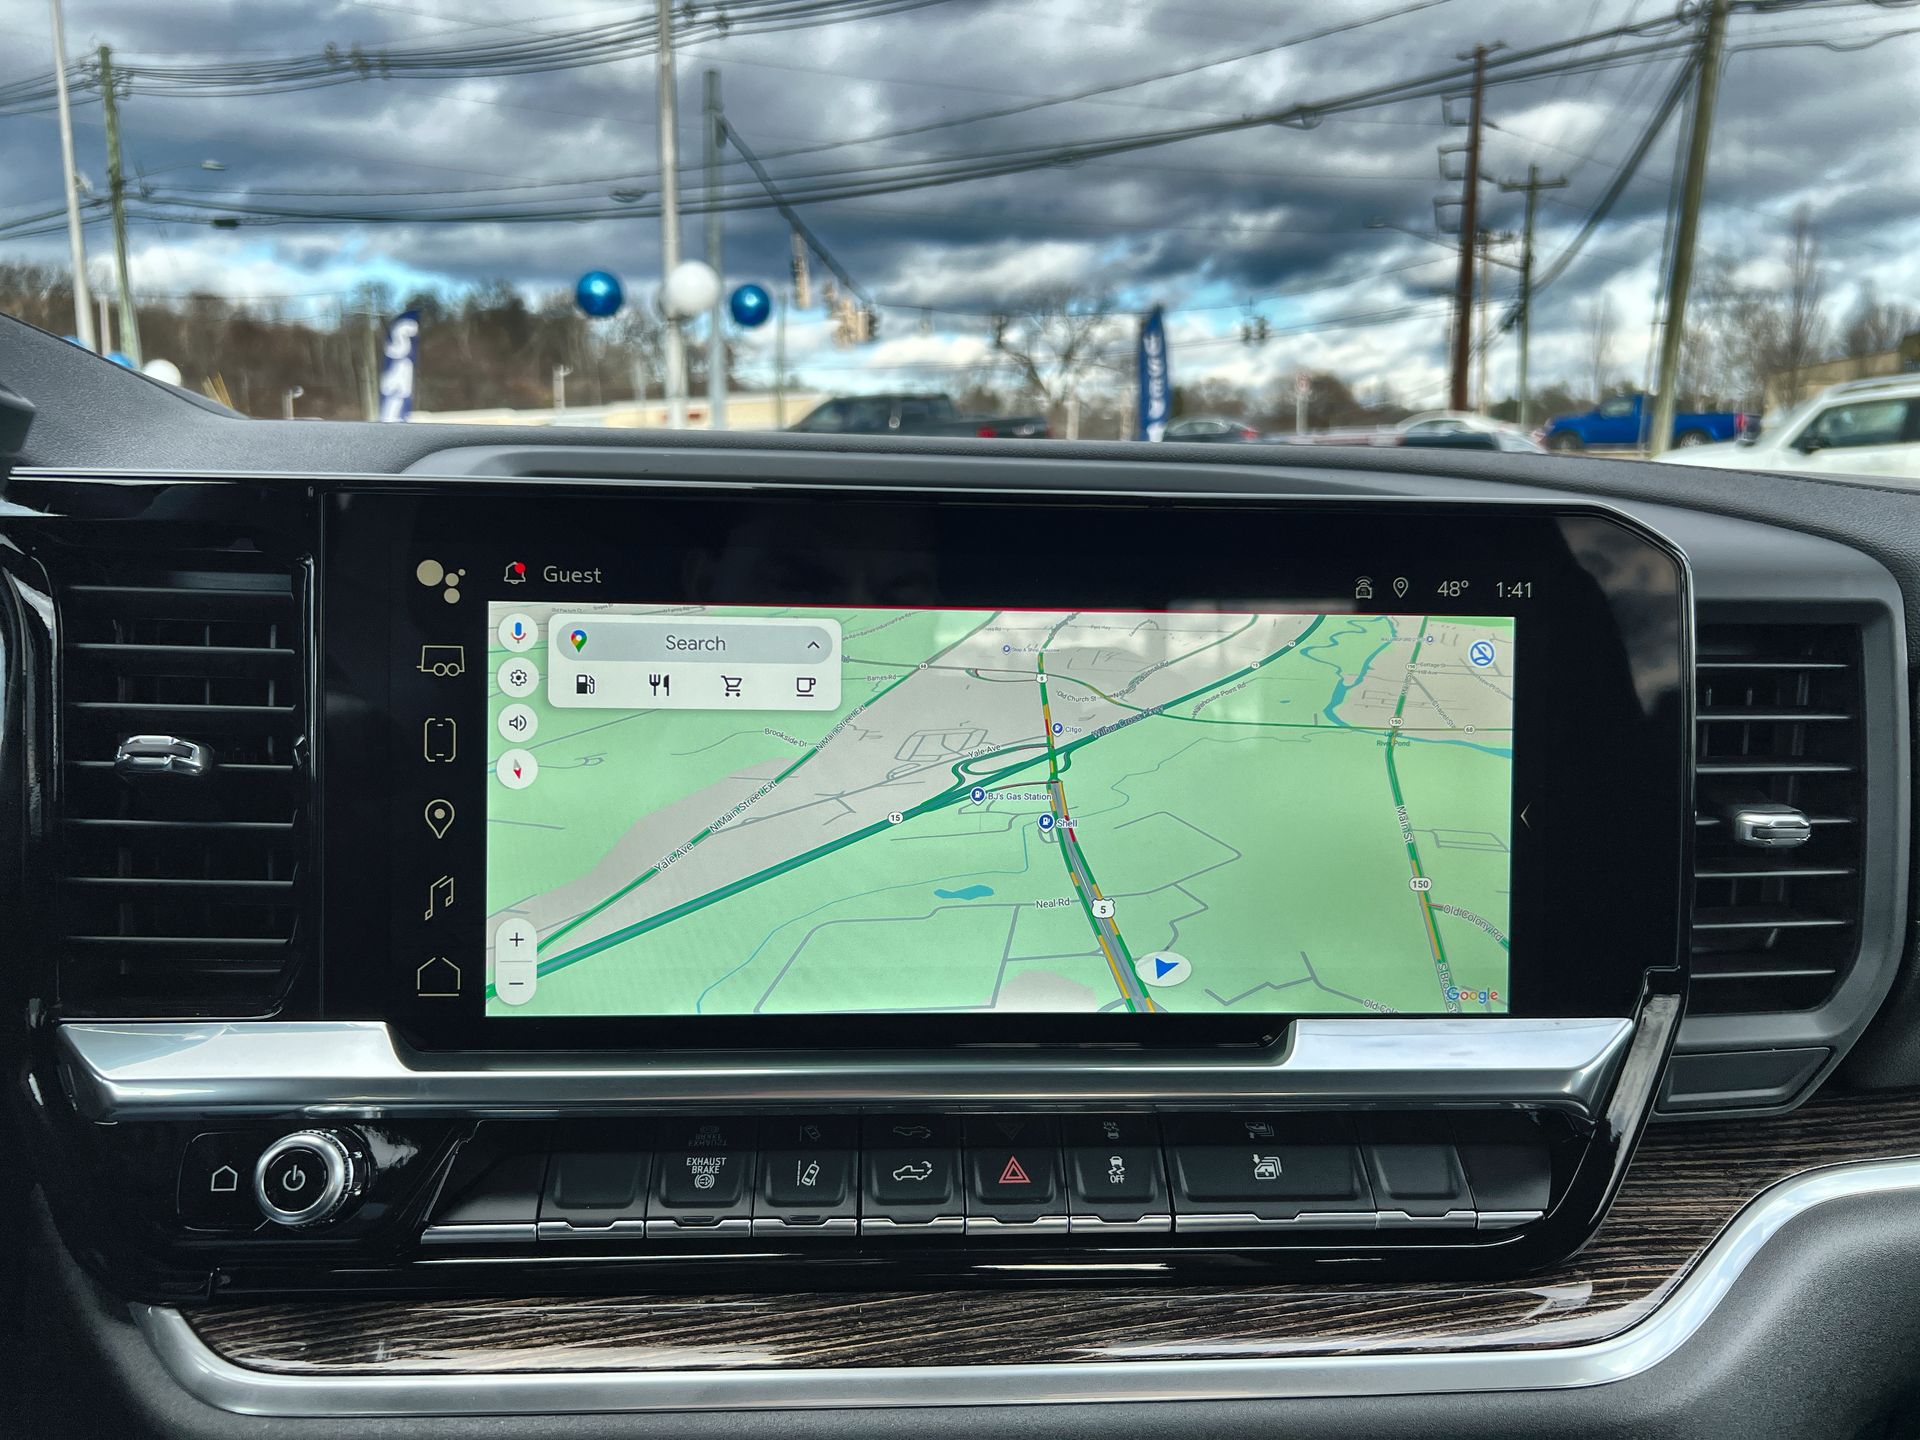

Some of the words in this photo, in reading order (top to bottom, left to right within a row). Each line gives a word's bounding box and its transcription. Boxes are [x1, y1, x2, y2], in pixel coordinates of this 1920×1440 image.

[543, 565, 602, 584] Guest
[1437, 580, 1469, 597] 48°
[1496, 581, 1533, 598] 1:41
[665, 634, 726, 651] Search
[1057, 690, 1067, 700] Old
[1067, 694, 1089, 702] Church
[1220, 686, 1238, 696] Point
[1237, 681, 1247, 690] Rd
[1432, 701, 1448, 721] Chapel
[822, 729, 839, 747] Main
[837, 712, 854, 731] Street
[853, 704, 866, 716] Ext
[1091, 725, 1117, 739] Wilbur
[1118, 713, 1142, 727] Cross
[764, 728, 799, 746] Brookside
[968, 749, 985, 759] Yale
[985, 744, 1001, 753] Ave
[709, 823, 718, 832] N
[718, 809, 740, 828] Main
[738, 791, 763, 811] Street
[762, 780, 777, 793] Ext
[1056, 819, 1078, 827] Shell
[1397, 806, 1411, 832] Main
[1403, 831, 1414, 844] St
[654, 855, 678, 871] Yale
[676, 842, 694, 858] Ave
[1412, 880, 1429, 889] 150
[1036, 900, 1056, 908] Neal
[1058, 897, 1070, 906] Rd
[1443, 904, 1460, 917] Old
[1461, 910, 1491, 933] Colony
[1490, 927, 1503, 942] Rd
[1447, 986, 1498, 1004] Google
[1363, 999, 1379, 1010] Old
[687, 1157, 727, 1166] EXHAUST
[691, 1165, 720, 1174] BRAKE
[1110, 1175, 1125, 1184] OFF
